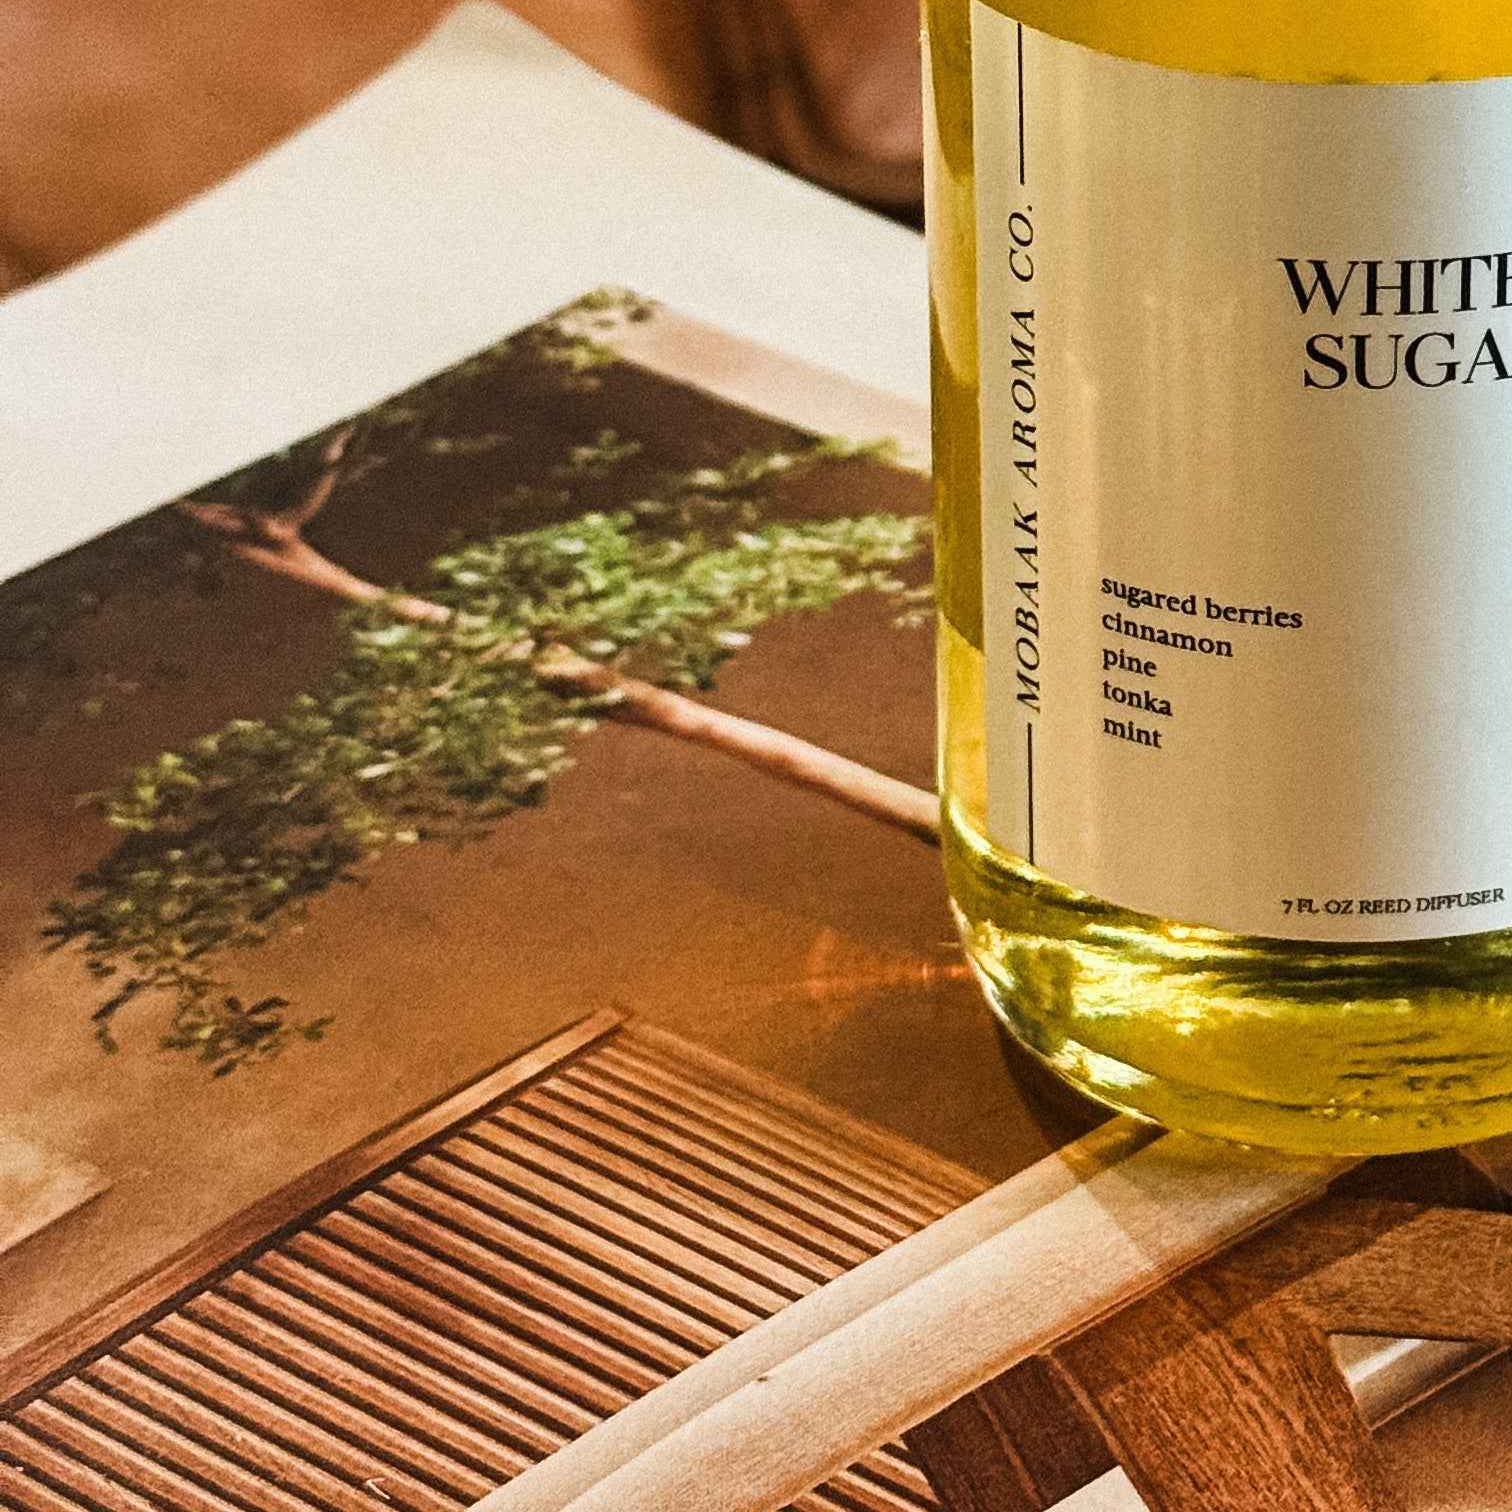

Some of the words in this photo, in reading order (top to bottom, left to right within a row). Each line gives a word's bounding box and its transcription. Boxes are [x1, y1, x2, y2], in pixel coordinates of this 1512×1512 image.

[1008, 205, 1033, 282] CO.
[1010, 310, 1037, 487] AROMA
[1013, 503, 1040, 713] MOBAAK
[1101, 578, 1197, 616] sugared
[1205, 598, 1302, 628] berries
[1101, 611, 1233, 657] cinnamon
[1103, 648, 1156, 677] pine
[1103, 680, 1172, 716] tonka
[1104, 718, 1161, 749] mint
[1282, 900, 1293, 914] 7
[1297, 898, 1320, 914] FL
[1324, 900, 1353, 914] OZ
[1358, 899, 1411, 914] REED
[1416, 888, 1504, 912] DIFFUSER
